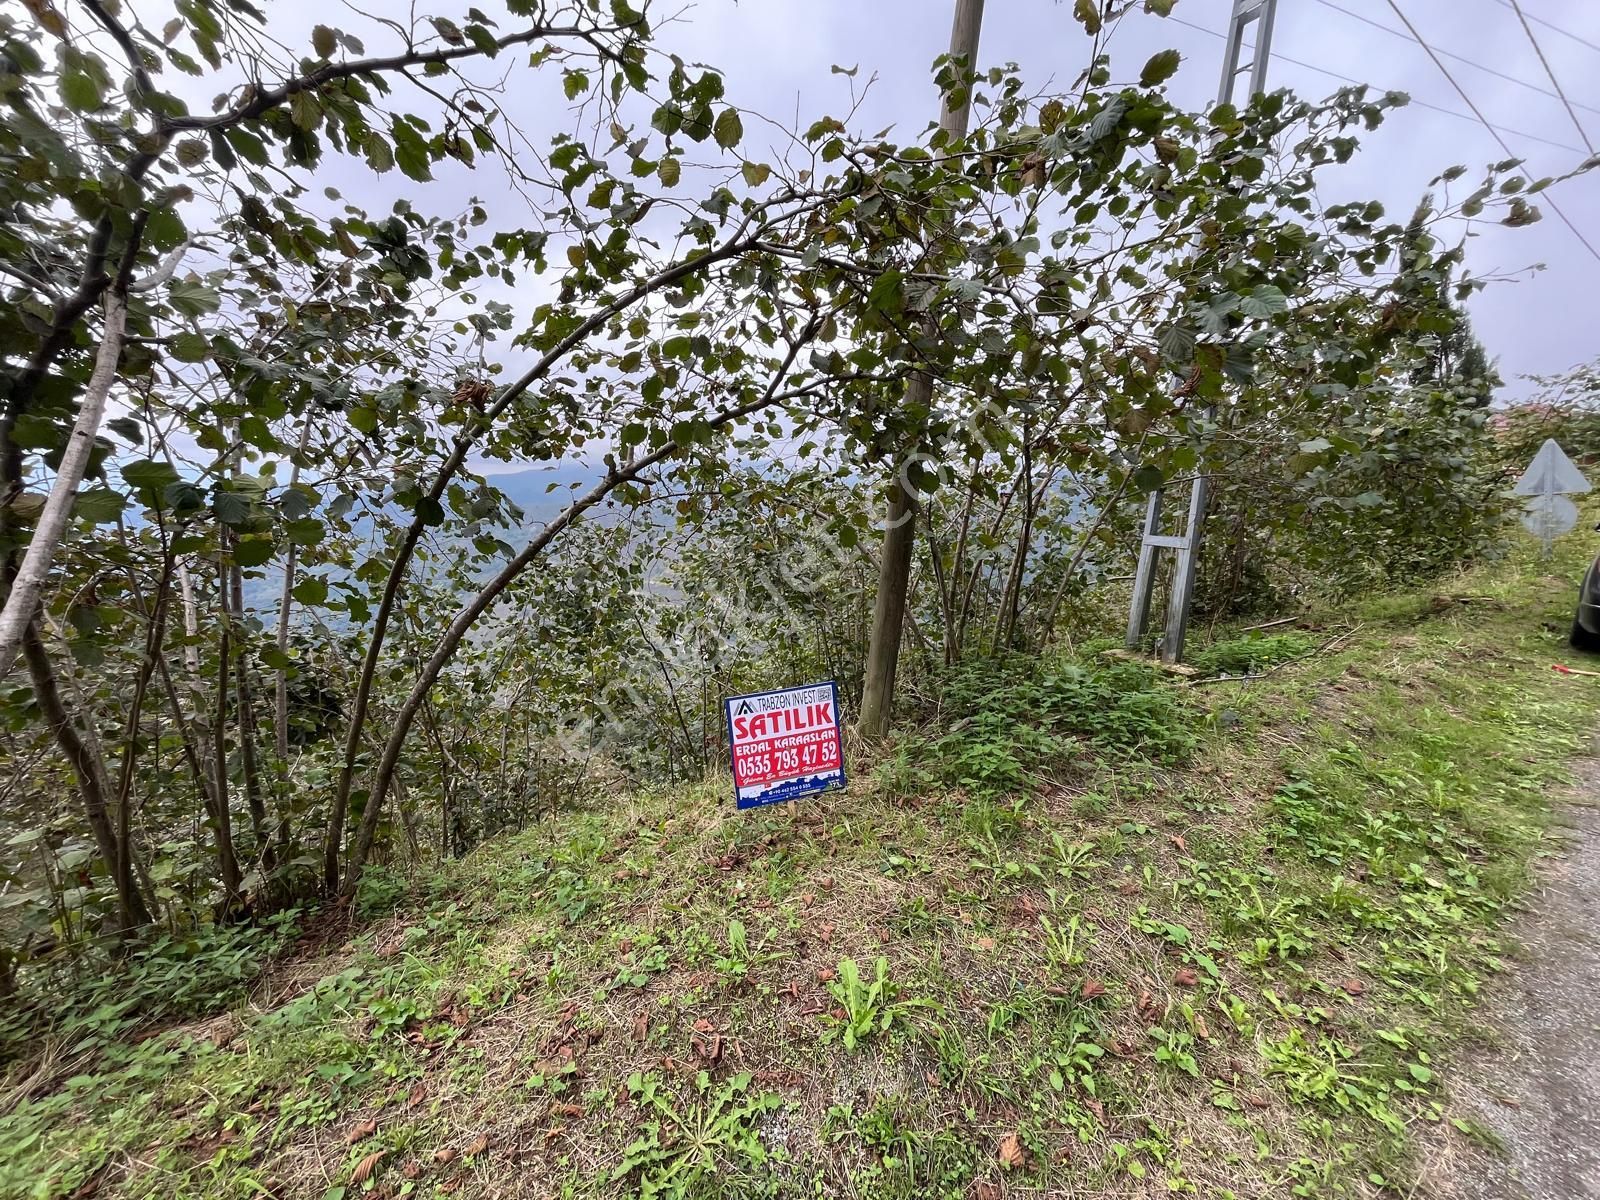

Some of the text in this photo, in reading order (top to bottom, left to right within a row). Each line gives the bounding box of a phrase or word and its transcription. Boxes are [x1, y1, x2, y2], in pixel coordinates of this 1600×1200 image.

[757, 690, 816, 712] TRABZON INVEST
[734, 703, 832, 741] SATILIK
[736, 729, 835, 757] ERDAL KARAASLAN
[738, 741, 837, 777] 0535 793 47 52
